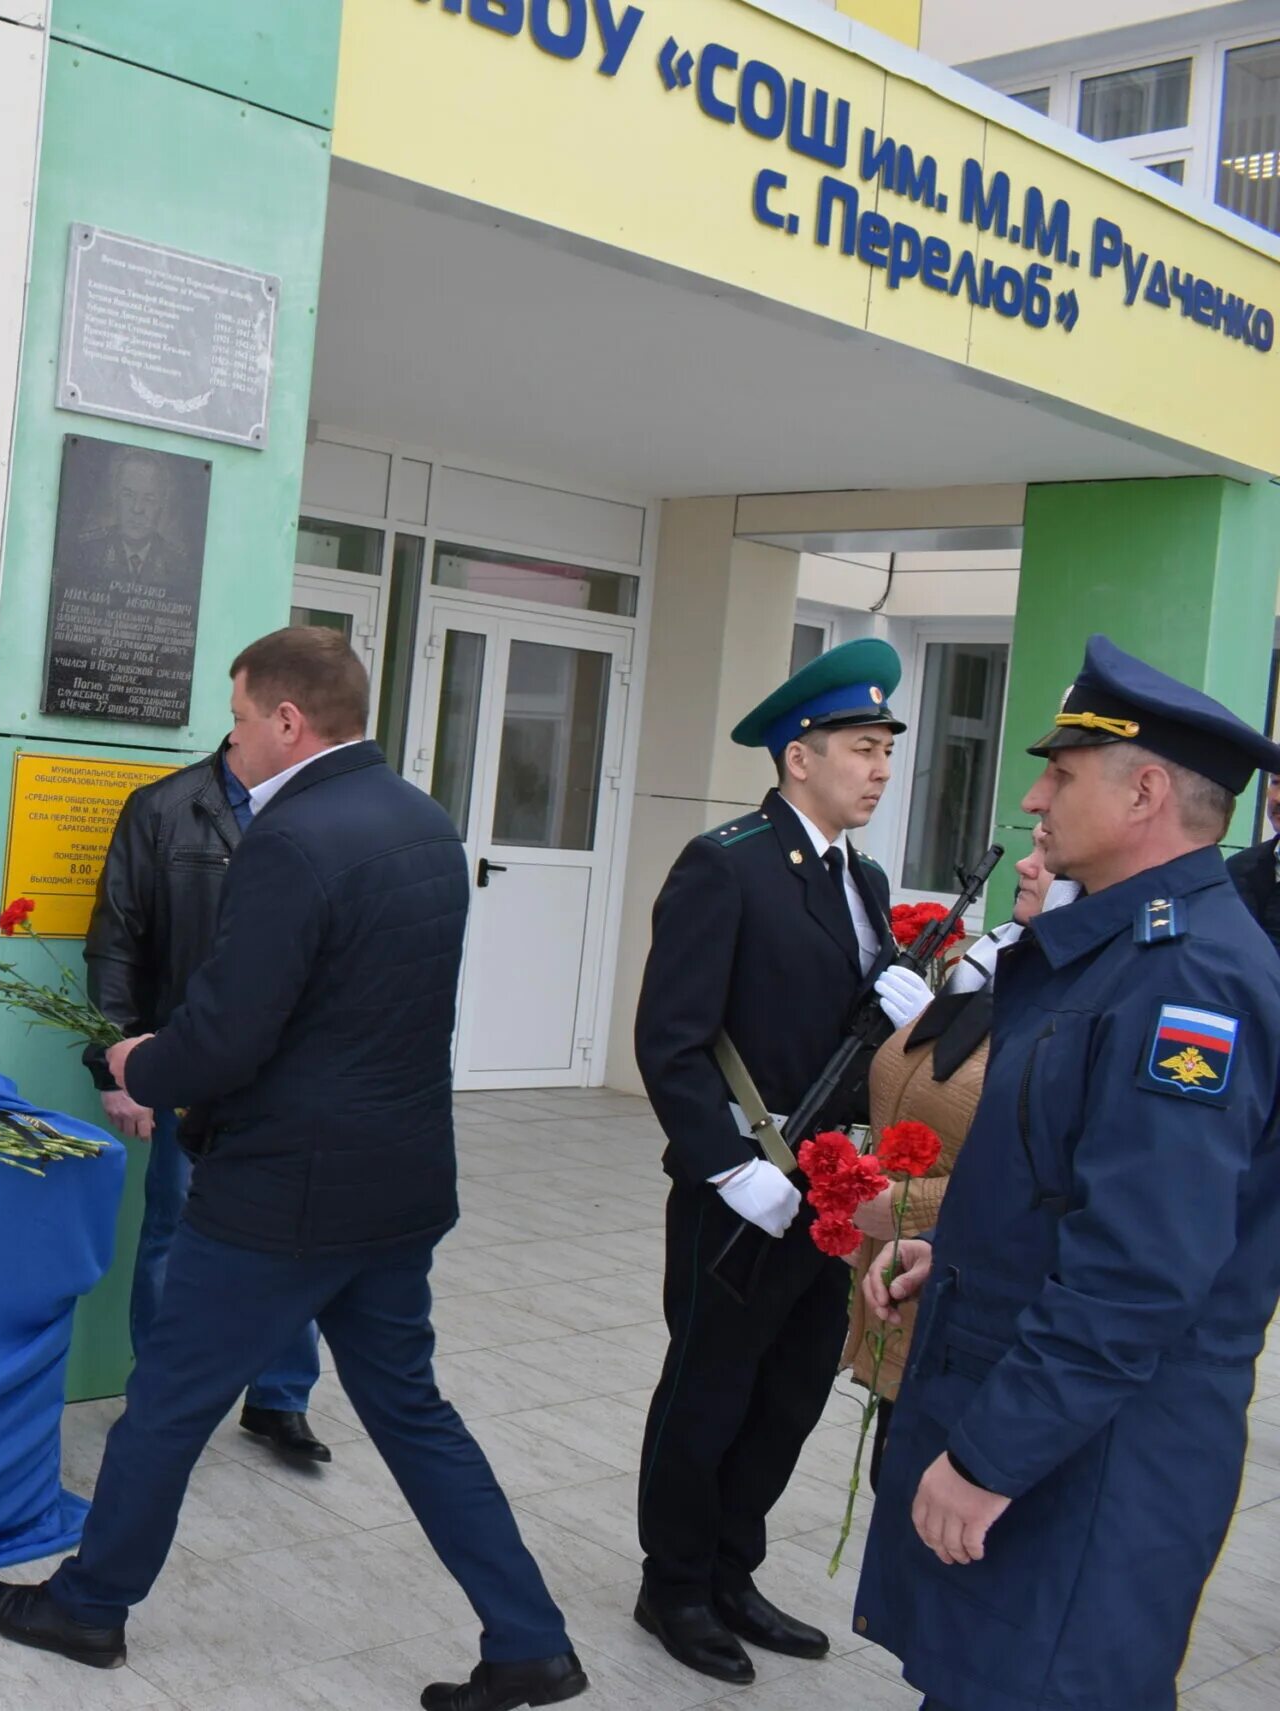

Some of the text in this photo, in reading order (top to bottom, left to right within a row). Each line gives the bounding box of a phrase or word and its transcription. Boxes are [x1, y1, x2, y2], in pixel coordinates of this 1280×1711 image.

[410, 0, 1276, 353] ОУ «СОШ им. М.М. Рудченко
[751, 167, 1081, 332] с. Перелюб»
[95, 700, 108, 712] 27
[51, 766, 116, 779] МУНИЦИПАЛЬНОЕ
[34, 774, 128, 789] ОБЩЕОБРАЗОВАТЕЛЬНОЕ
[24, 793, 63, 802] «СРЕДНЯЯ
[28, 812, 48, 821] СЕЛА
[50, 814, 87, 823] ПЕРЕЛЮБ
[57, 824, 109, 834] САРАТОВСКОЙ
[71, 843, 97, 852] РЕЖИМ
[70, 863, 91, 875] 8.00
